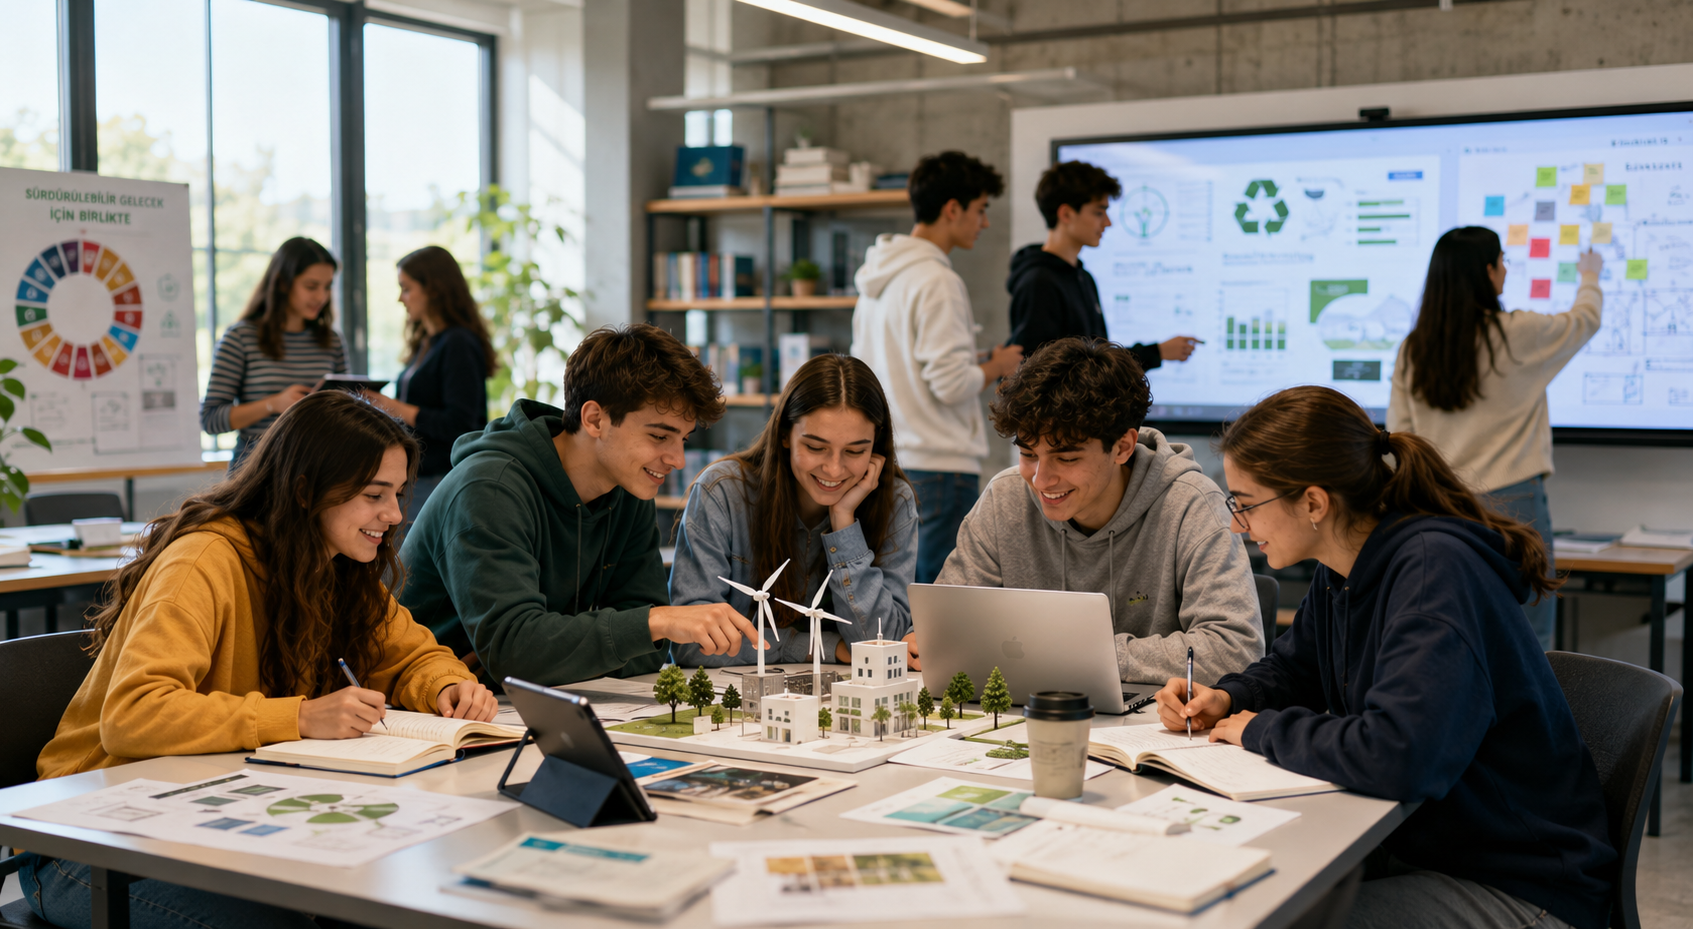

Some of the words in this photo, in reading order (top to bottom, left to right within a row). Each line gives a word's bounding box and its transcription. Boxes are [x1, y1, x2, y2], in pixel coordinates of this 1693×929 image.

[25, 187, 116, 205] SÜRDÜRÜLEBİLİR
[120, 194, 164, 209] GELECEK
[50, 206, 75, 223] İÇİN
[79, 209, 132, 225] BİRLİKTE
